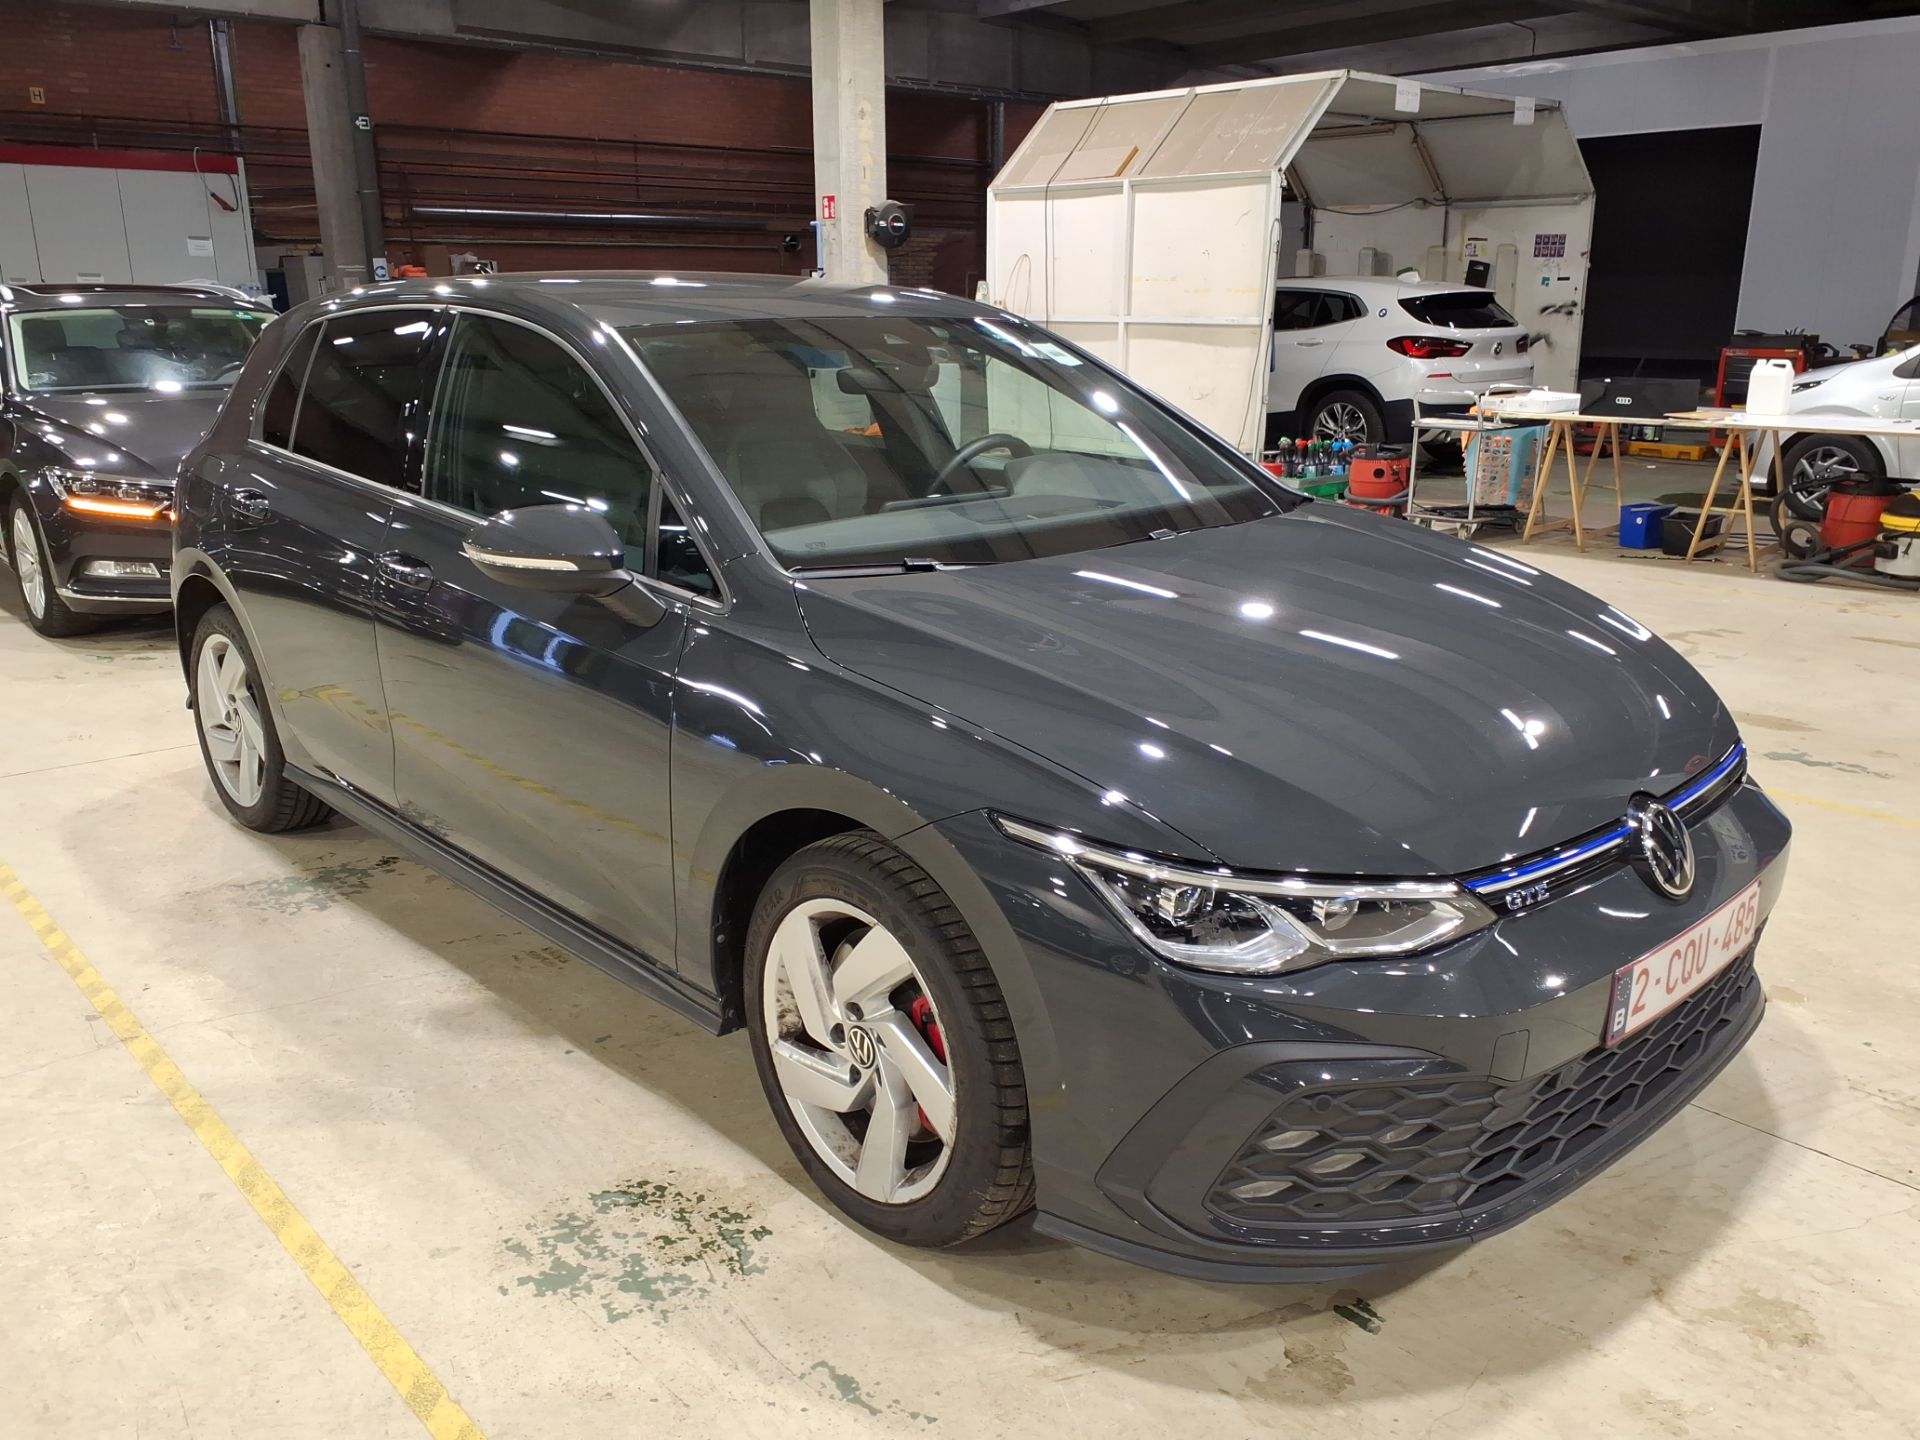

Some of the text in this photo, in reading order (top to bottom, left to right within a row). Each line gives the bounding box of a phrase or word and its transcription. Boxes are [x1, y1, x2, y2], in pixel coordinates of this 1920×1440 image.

[1505, 880, 1550, 910] GTE
[1631, 893, 1757, 1016] 2-CQU-485
[1612, 1007, 1626, 1033] B
